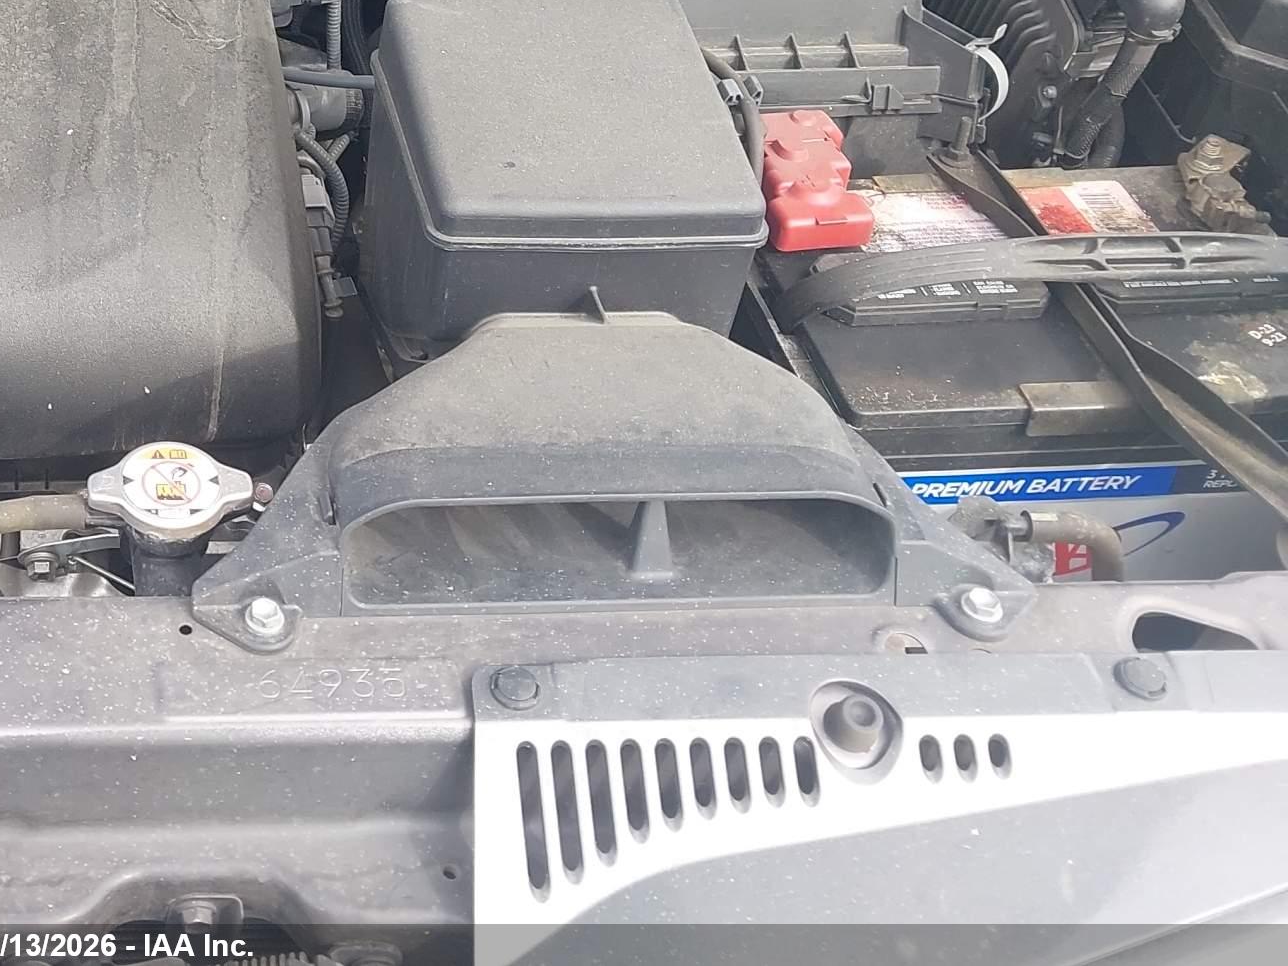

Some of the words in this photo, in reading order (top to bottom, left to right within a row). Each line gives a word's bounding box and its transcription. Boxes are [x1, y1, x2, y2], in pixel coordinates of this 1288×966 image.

[912, 479, 1026, 499] PREMIUM
[1026, 474, 1143, 495] BATTERY
[258, 667, 408, 699] 64935
